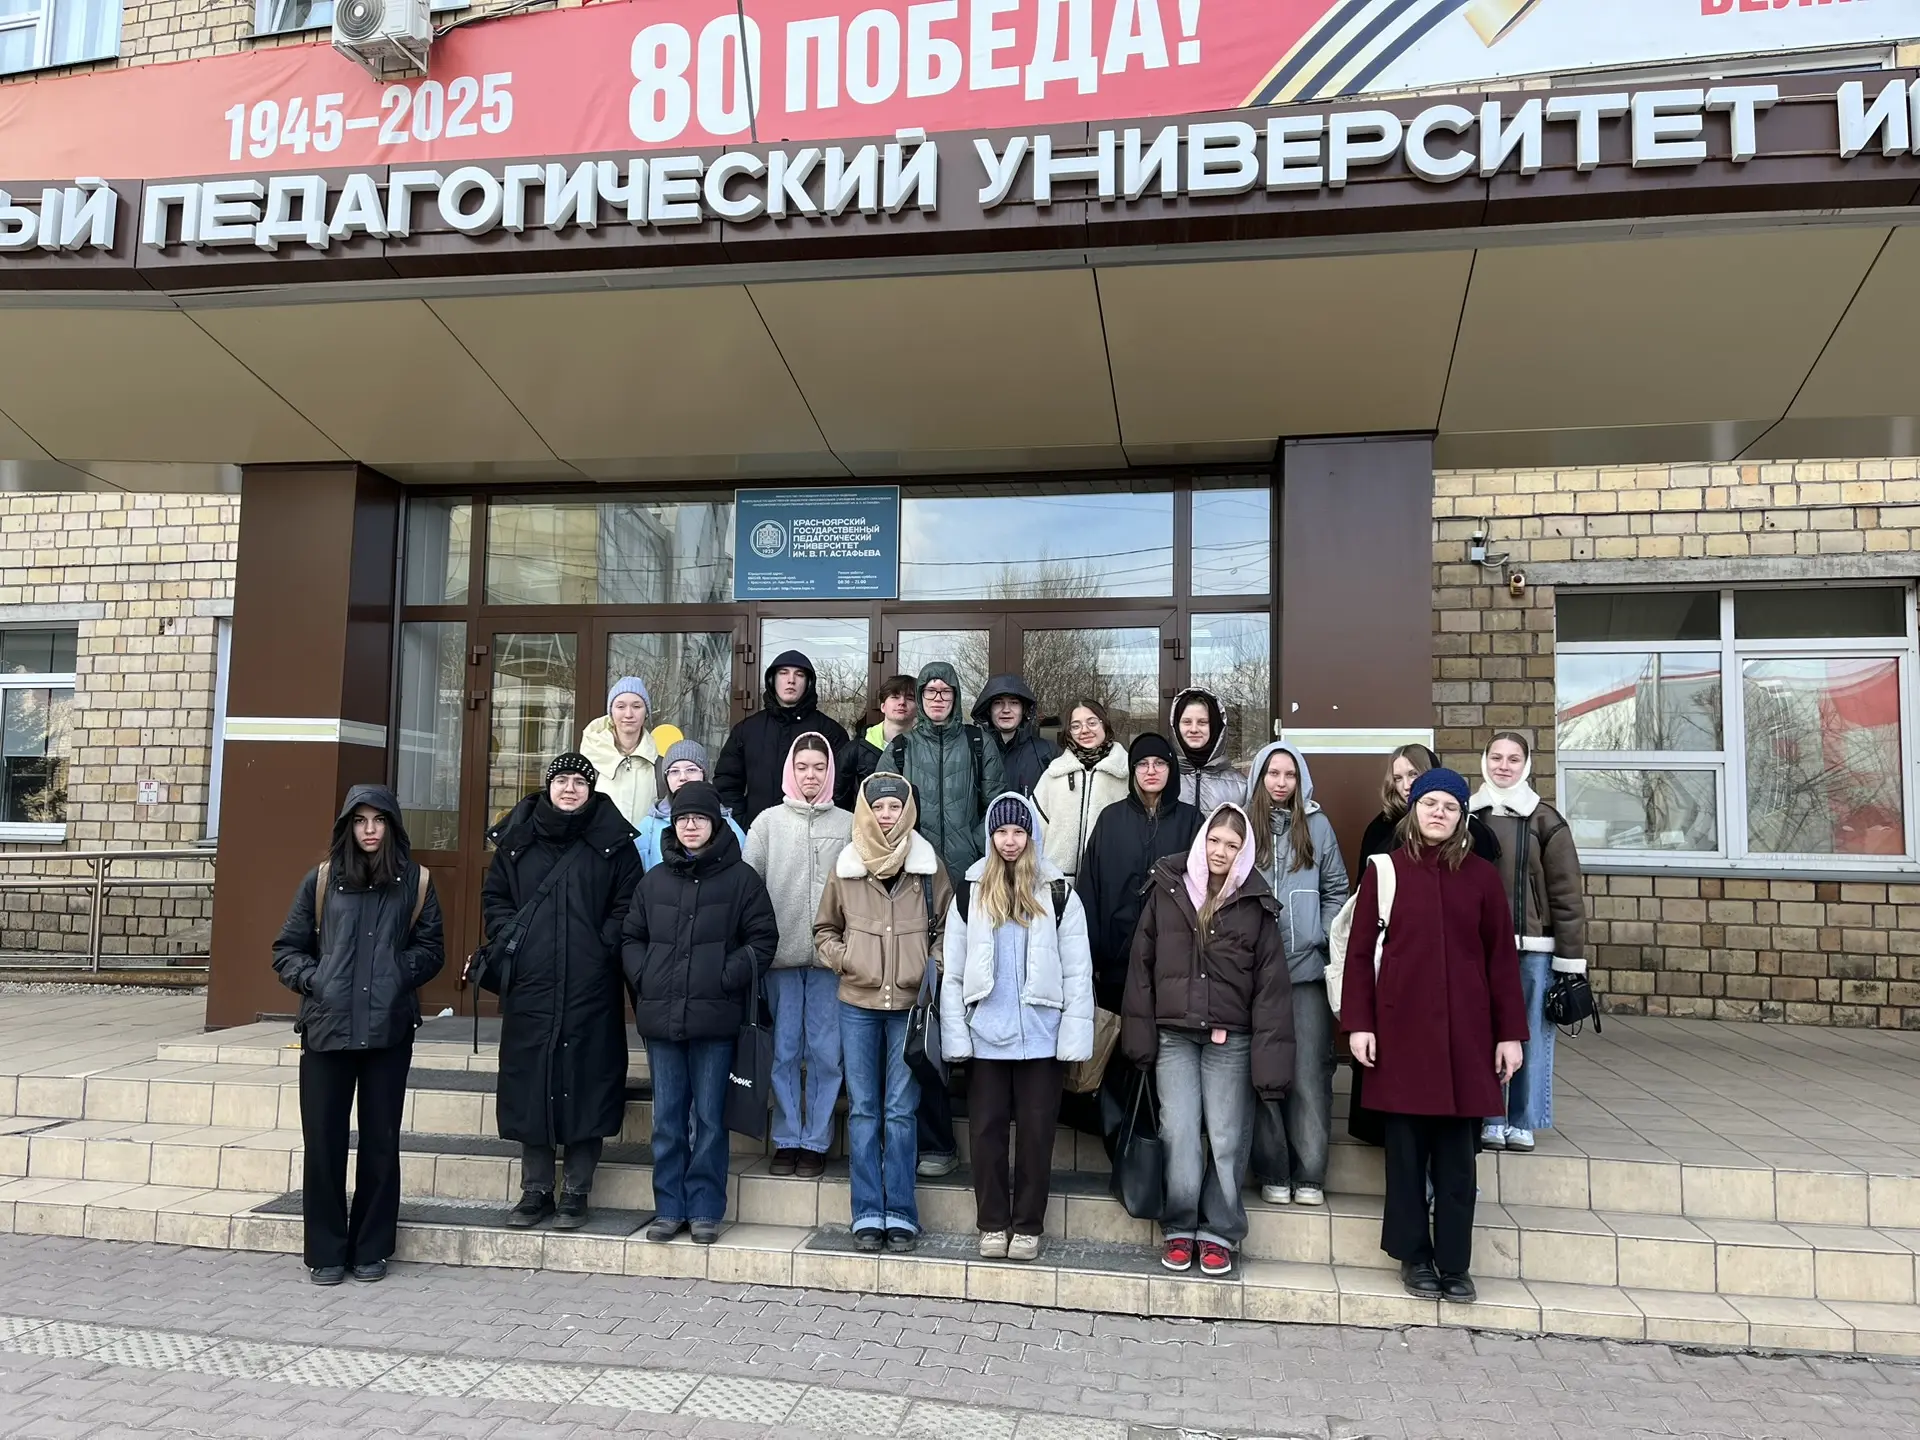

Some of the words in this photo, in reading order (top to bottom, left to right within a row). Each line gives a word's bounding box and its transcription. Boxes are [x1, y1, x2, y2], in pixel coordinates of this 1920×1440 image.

[628, 13, 761, 144] 80
[785, 0, 1201, 113] ПОБЕДА!
[141, 127, 938, 252] ПЕДАГОГИЧЕСКИЙ
[972, 85, 1780, 210] УНИВЕРСИТЕТ
[793, 517, 866, 526] КРАСНОЯРСКИЙ
[793, 525, 880, 534] ГОСУДАРСТВЕННЫЙ
[793, 532, 872, 542] ПЕДАГОГИЧЕСКИЙ
[830, 549, 881, 557] АСТАФЬЕВА
